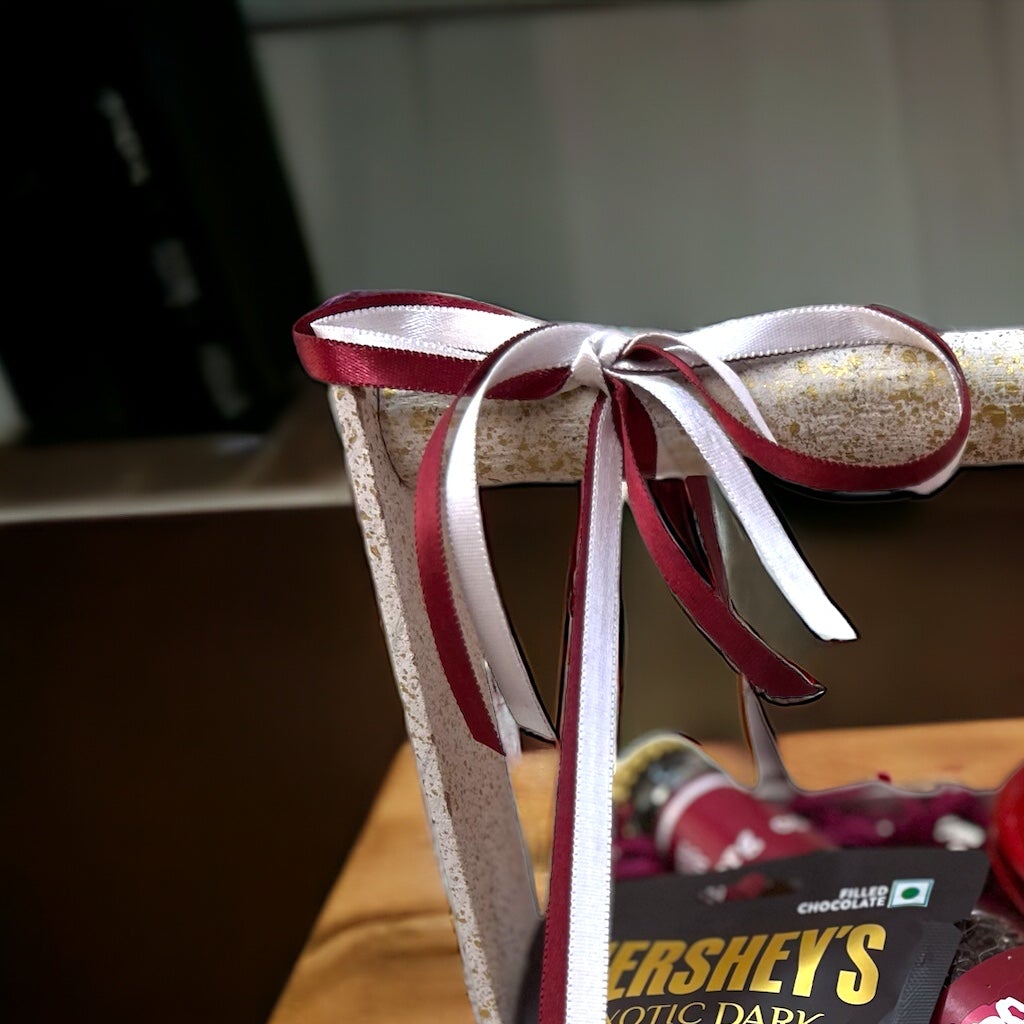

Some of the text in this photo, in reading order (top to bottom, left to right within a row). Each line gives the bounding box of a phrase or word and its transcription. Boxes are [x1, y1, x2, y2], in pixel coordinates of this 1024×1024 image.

[839, 885, 889, 899] FILLED
[797, 896, 886, 914] CHOCOLATE
[607, 923, 887, 1006] ERSHEY'S
